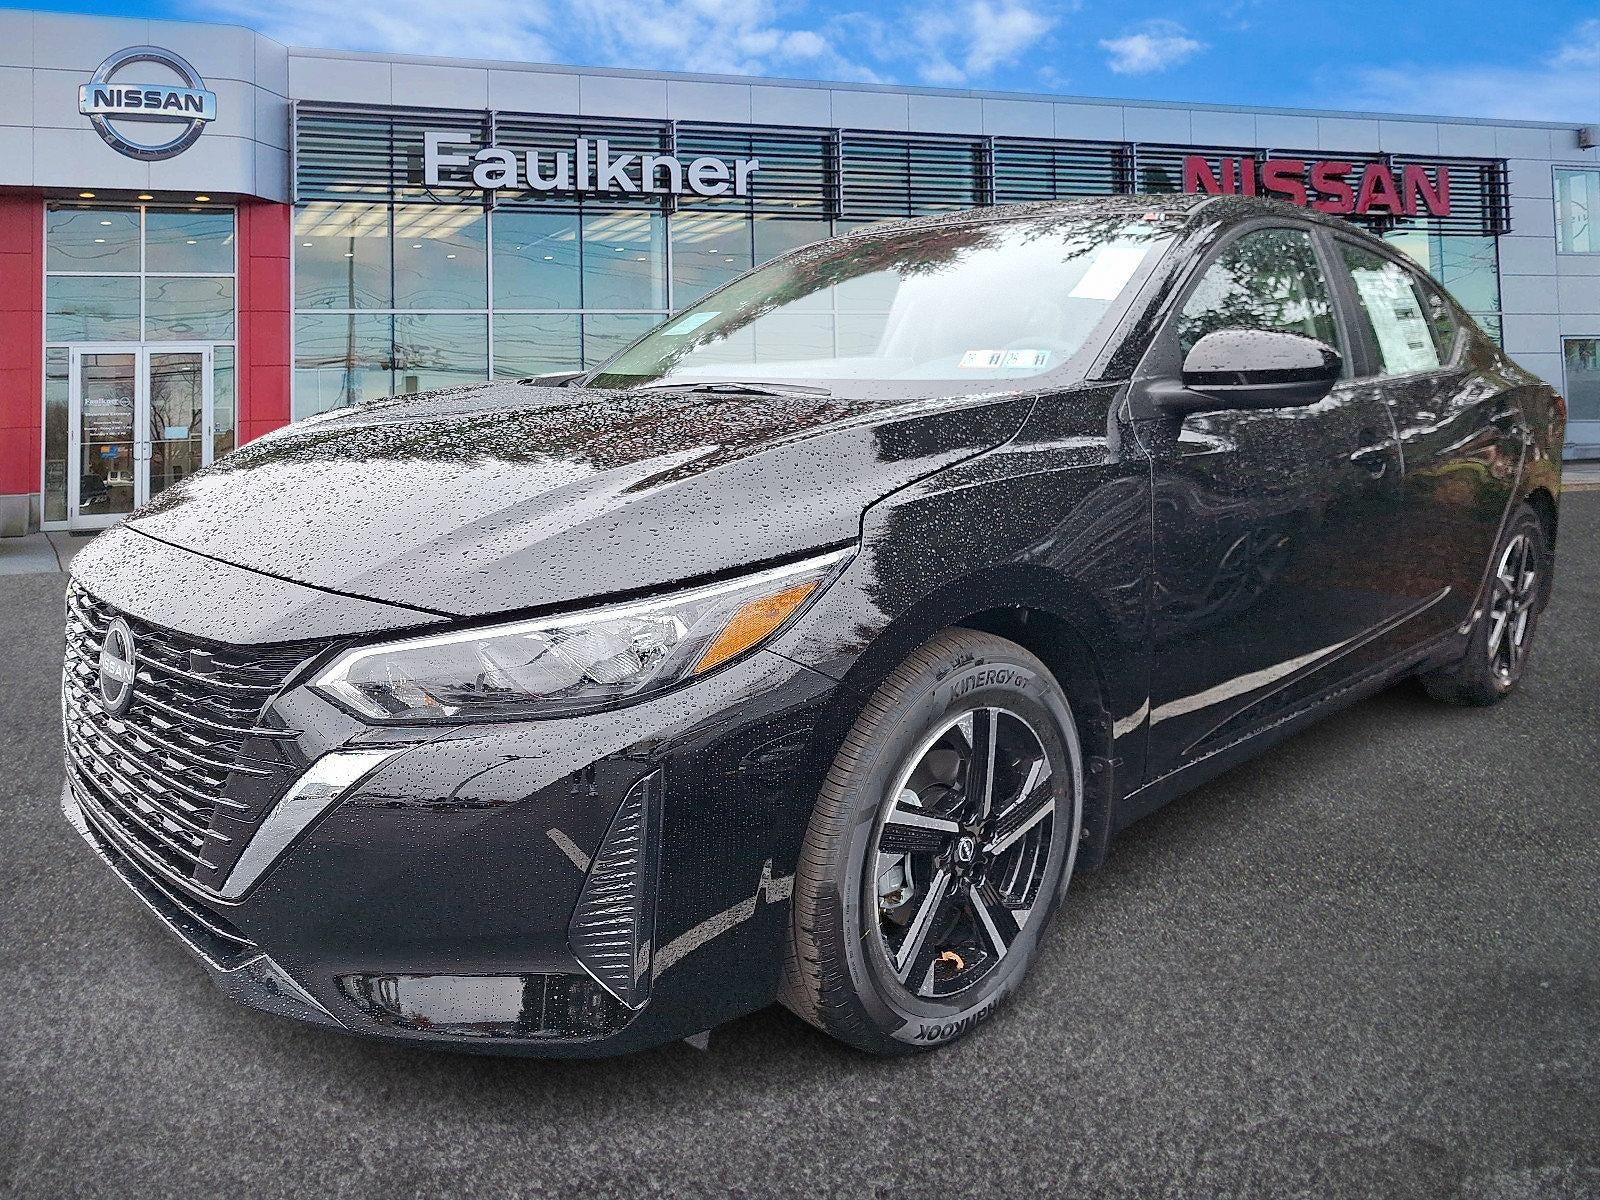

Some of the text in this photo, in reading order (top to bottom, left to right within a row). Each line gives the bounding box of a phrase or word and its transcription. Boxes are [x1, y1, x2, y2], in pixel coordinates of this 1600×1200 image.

[93, 89, 204, 113] NISSAN
[423, 131, 760, 196] Faulkner
[1182, 154, 1450, 216] NISSAN
[102, 657, 132, 681] SSAN
[950, 669, 1029, 699] KINERGY GT
